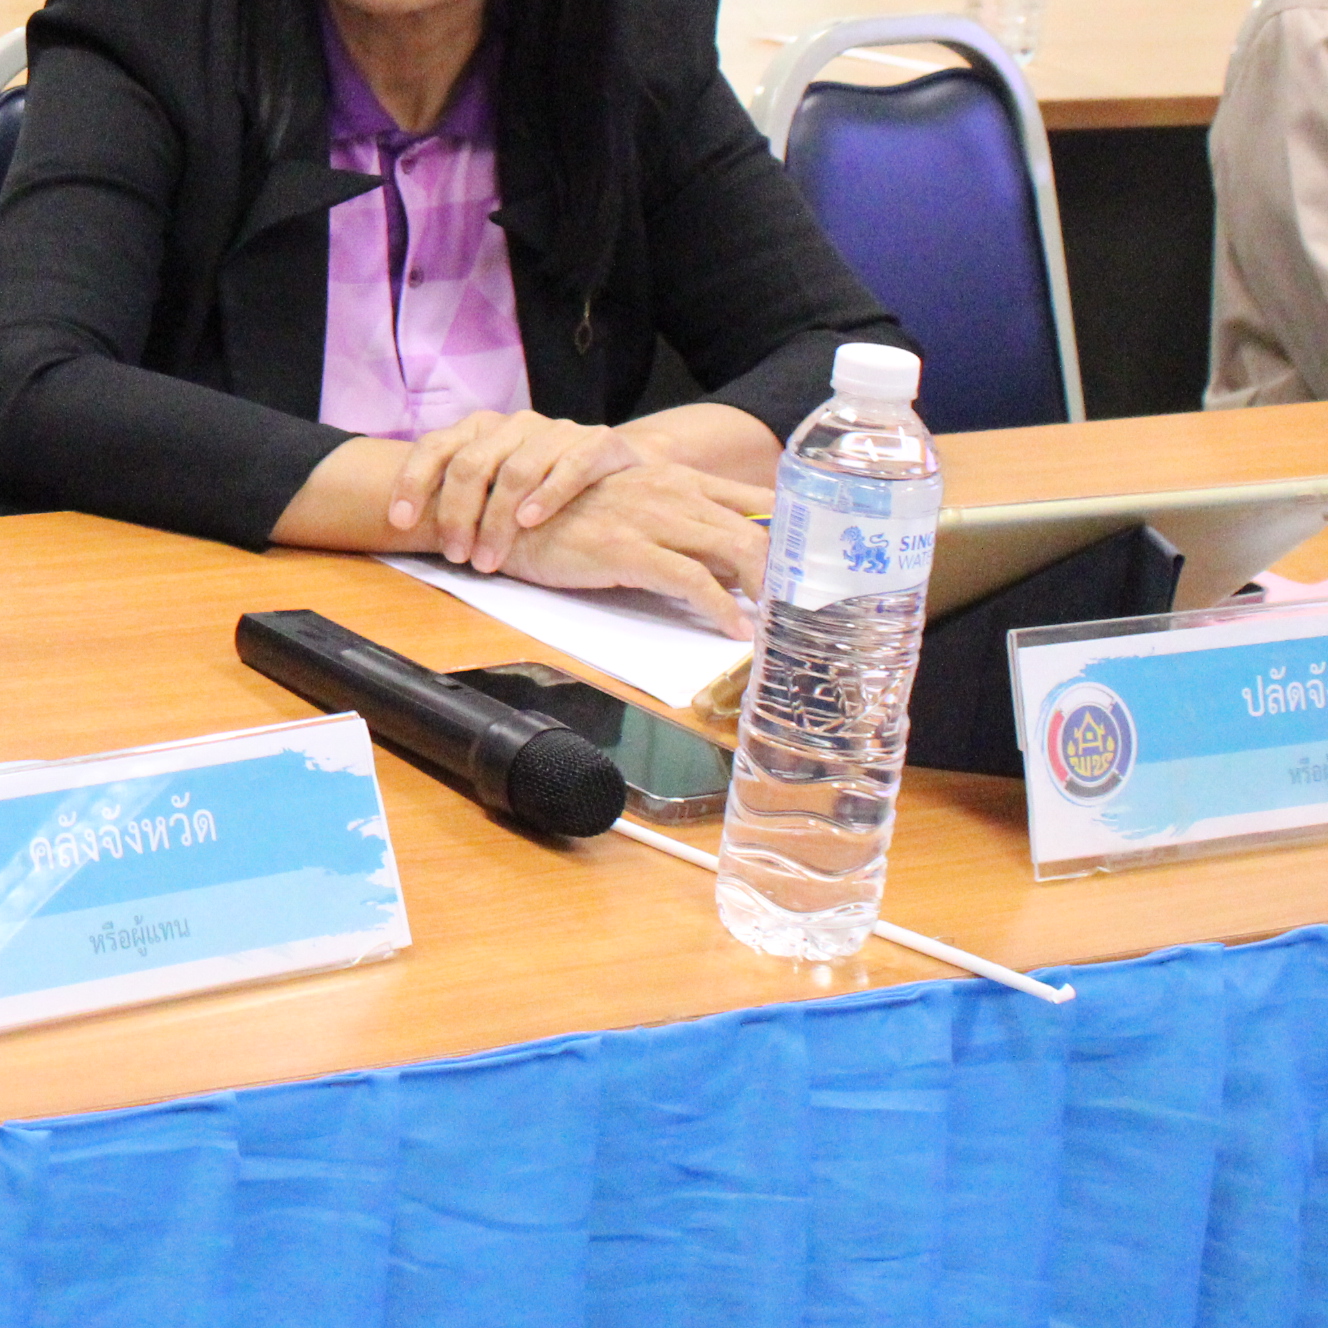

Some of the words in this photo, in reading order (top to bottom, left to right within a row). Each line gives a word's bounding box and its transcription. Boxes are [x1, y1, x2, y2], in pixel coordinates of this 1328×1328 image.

[1242, 661, 1328, 717] ปลัดจั
[1288, 754, 1328, 785] หรือ
[29, 792, 217, 872] คลังจังหวัด
[89, 915, 191, 957] หรือผู้แทน
